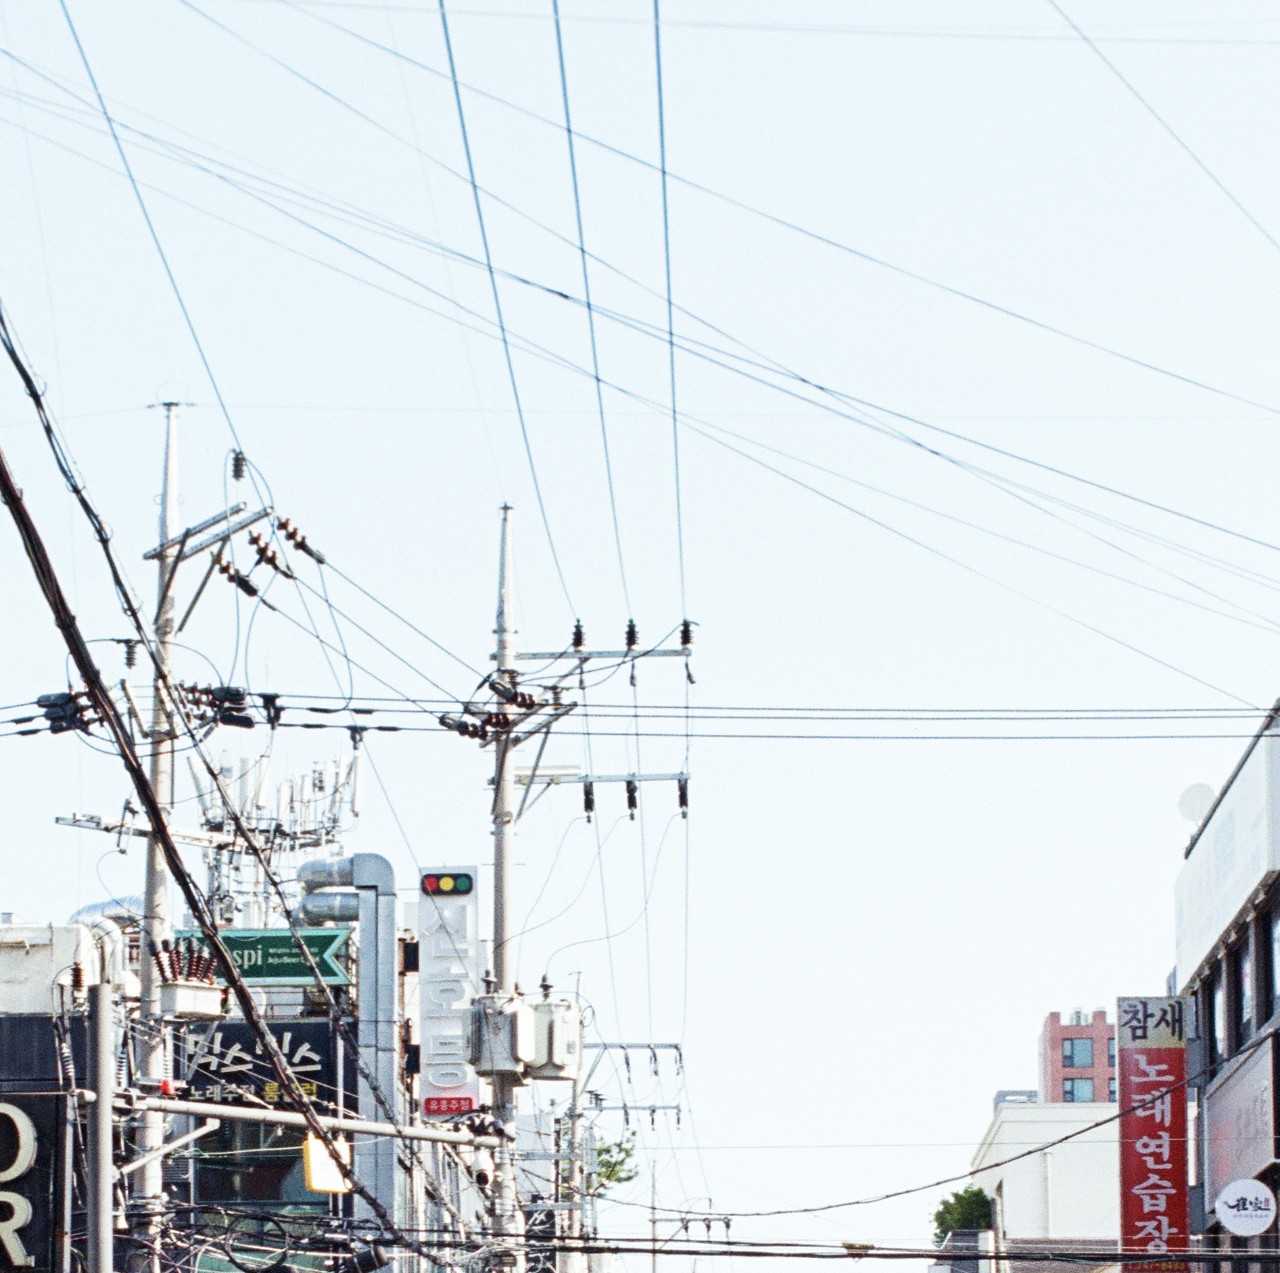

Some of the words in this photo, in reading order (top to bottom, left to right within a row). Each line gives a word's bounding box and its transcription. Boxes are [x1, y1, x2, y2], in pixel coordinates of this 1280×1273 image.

[231, 944, 263, 970] spi
[1121, 1000, 1185, 1041] 참새
[429, 1098, 470, 1112] 유흥주점
[1129, 1054, 1179, 1255] 노래연습장
